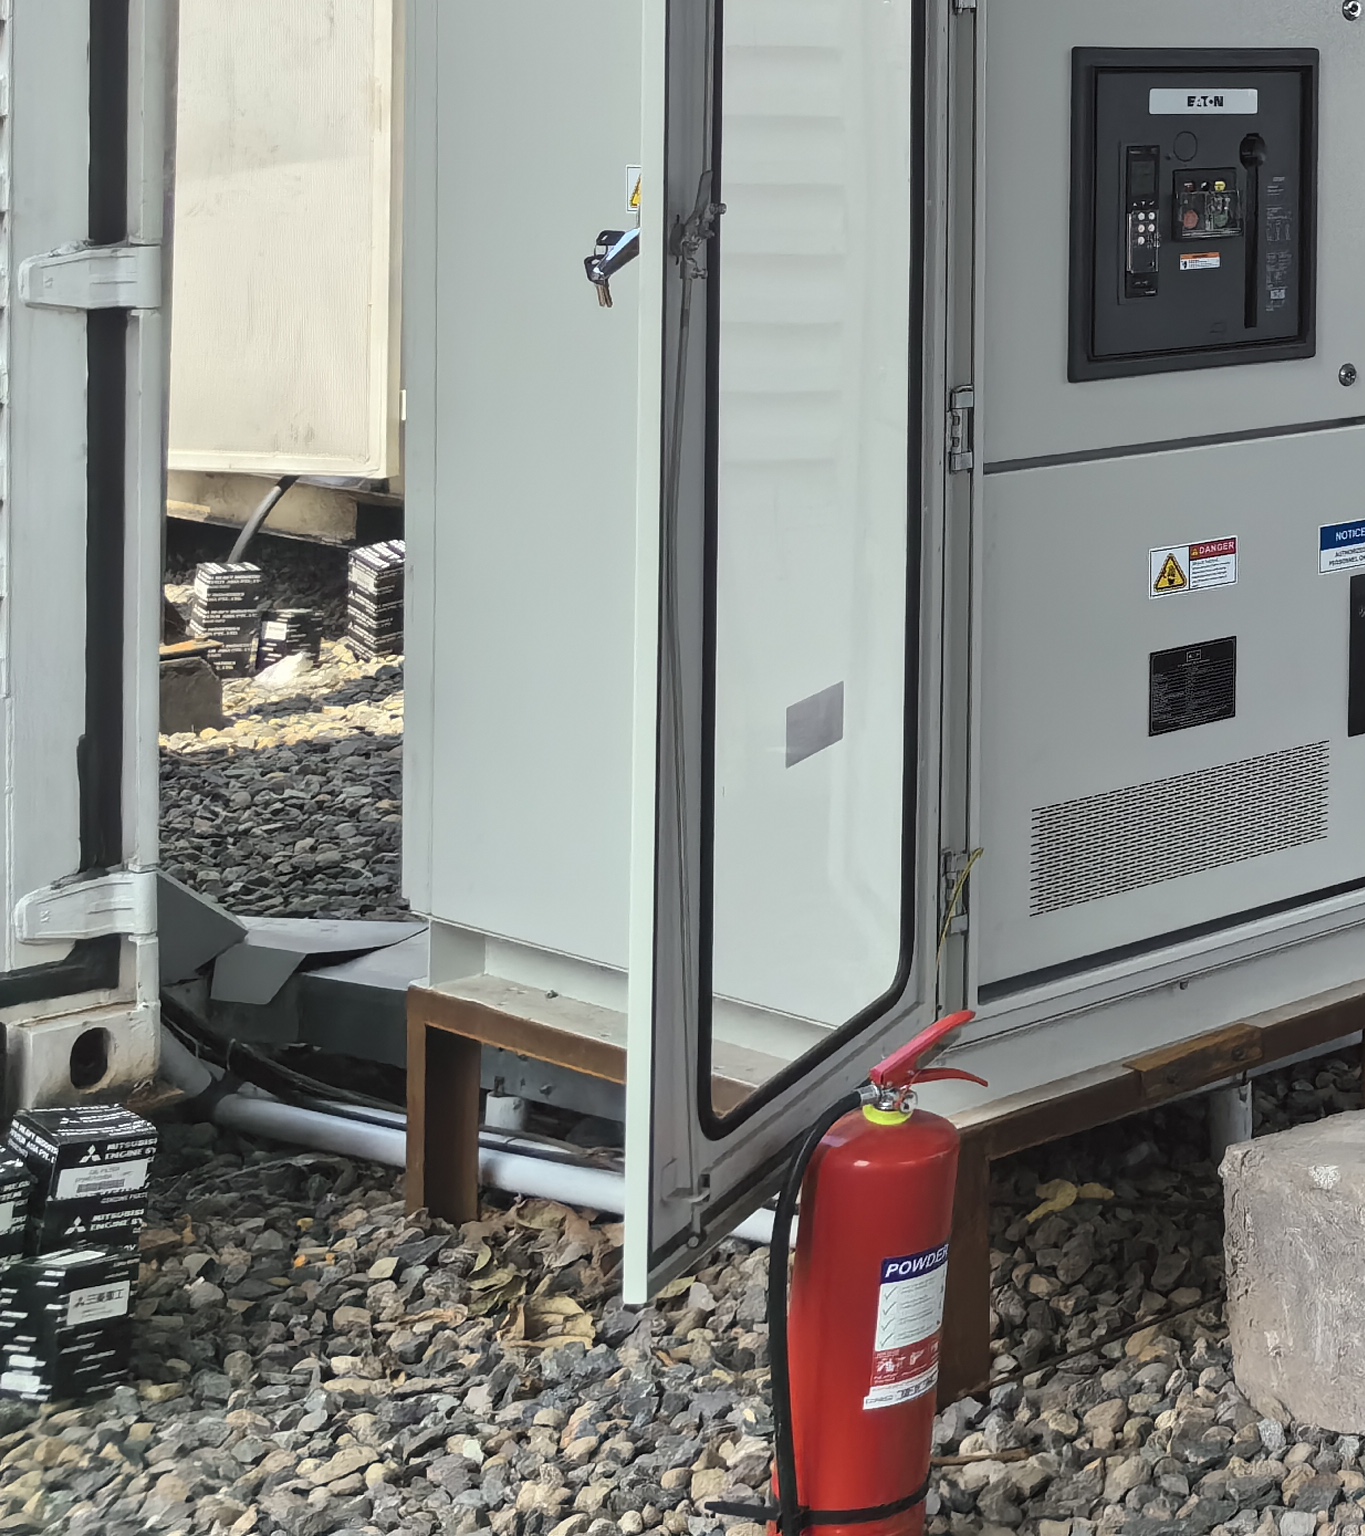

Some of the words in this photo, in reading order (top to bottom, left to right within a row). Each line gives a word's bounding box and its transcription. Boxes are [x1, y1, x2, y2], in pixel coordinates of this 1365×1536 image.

[1336, 527, 1365, 541] NOTICE
[1199, 541, 1235, 555] DANGER
[885, 1243, 949, 1278] POWDER
